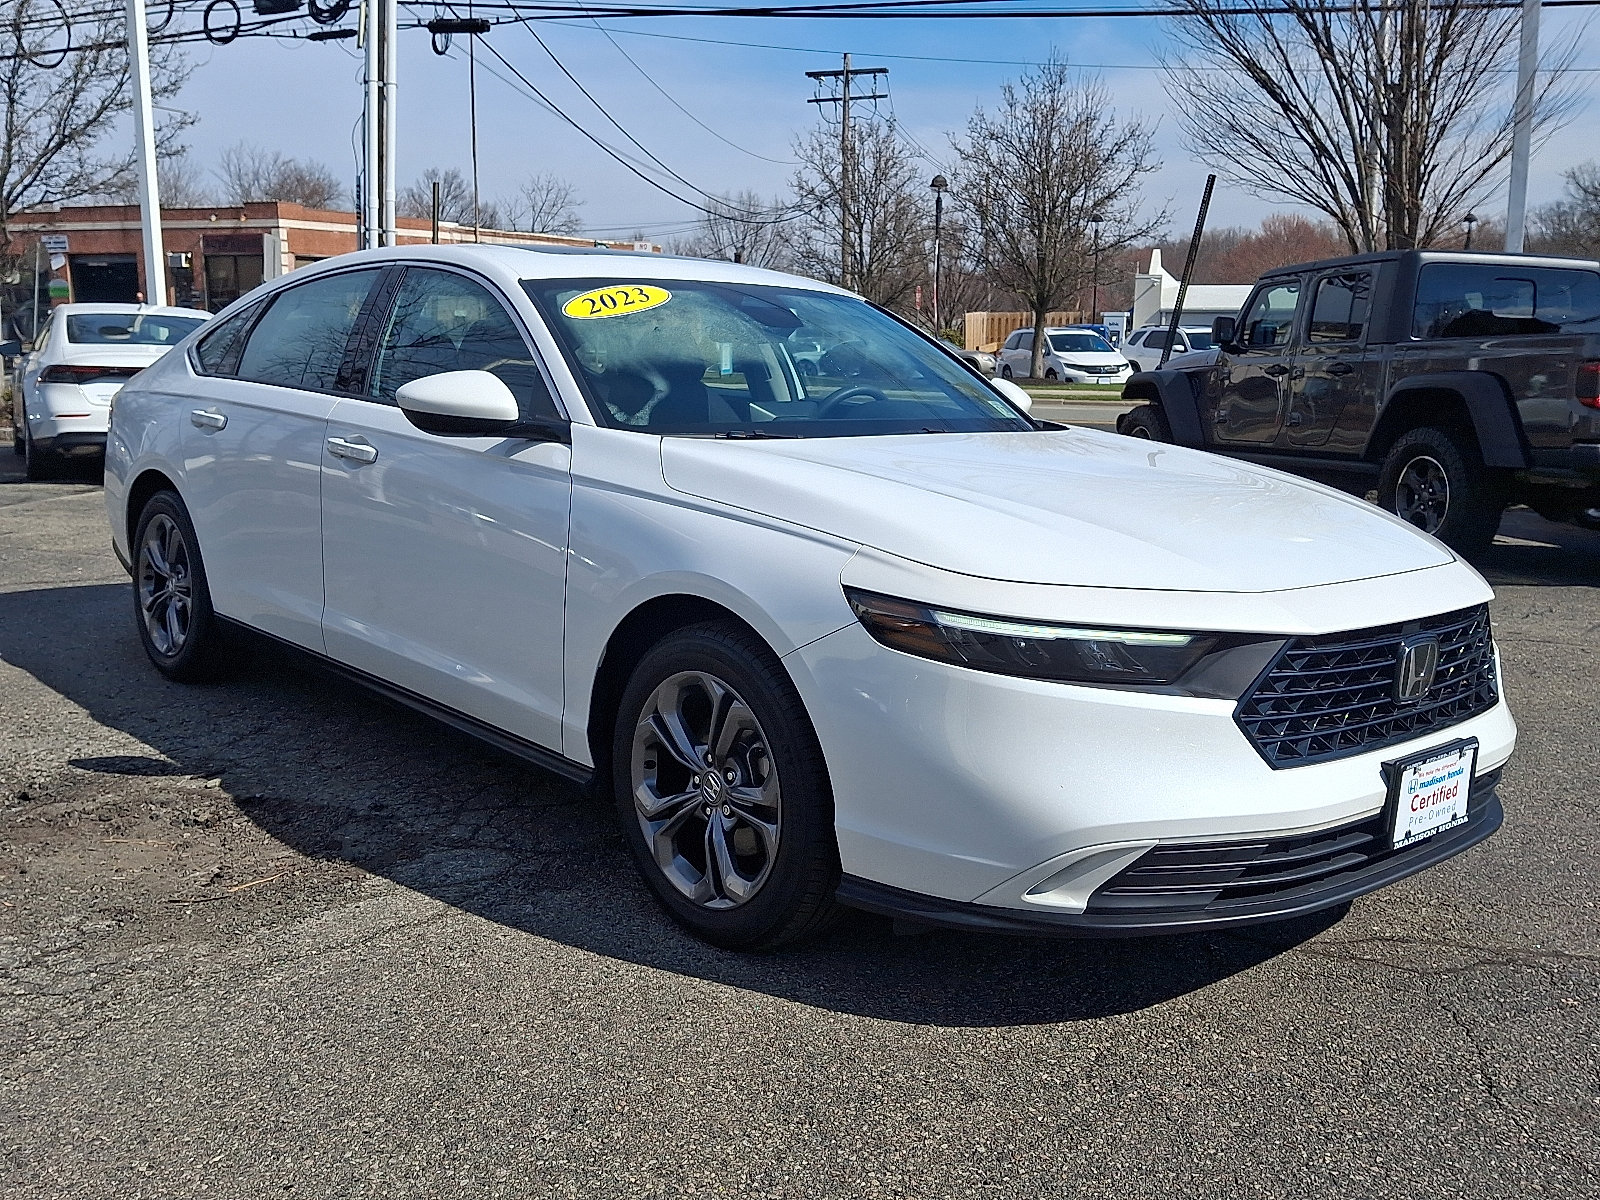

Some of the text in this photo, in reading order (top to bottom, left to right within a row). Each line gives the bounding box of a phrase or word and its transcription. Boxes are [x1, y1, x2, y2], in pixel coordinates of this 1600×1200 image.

[582, 287, 650, 315] 2023
[1418, 766, 1465, 790] madison honda
[1410, 779, 1459, 812] Certified
[1408, 800, 1457, 827] Pre-Owned
[1393, 815, 1469, 850] MADISON HONDA
